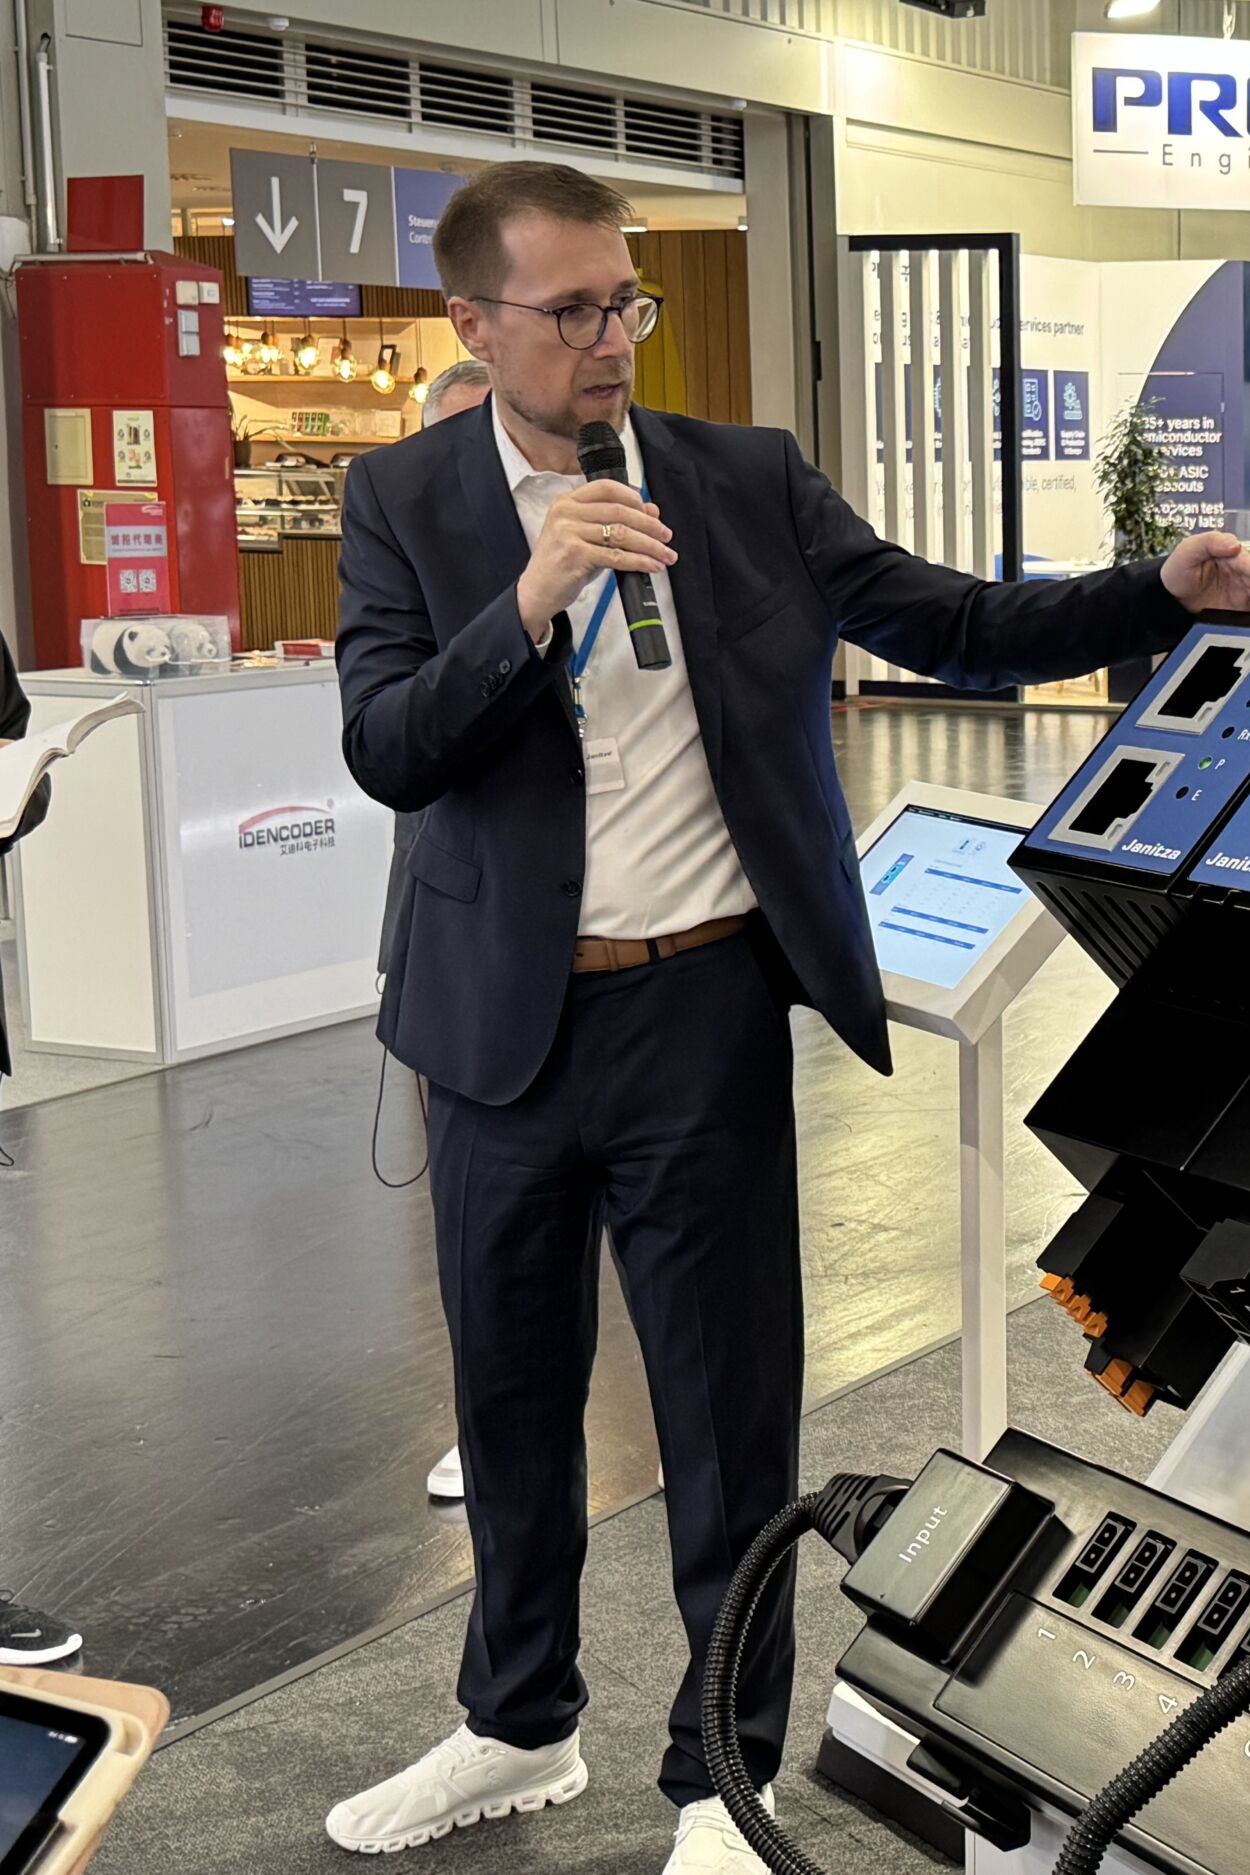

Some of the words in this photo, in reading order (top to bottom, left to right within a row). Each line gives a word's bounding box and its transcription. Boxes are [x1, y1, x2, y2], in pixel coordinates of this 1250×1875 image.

[343, 188, 368, 254] 7
[1053, 321, 1085, 338] partner
[1166, 419, 1201, 432] years
[1202, 416, 1215, 429] in
[1179, 466, 1209, 479] ASIC
[1201, 501, 1225, 514] test
[1214, 758, 1226, 770] P
[1191, 789, 1203, 801] E
[1121, 839, 1182, 861] Janitza
[1230, 1286, 1246, 1295] 1
[898, 1505, 948, 1563] Input
[1038, 1628, 1056, 1640] 1
[1072, 1650, 1096, 1669] 2
[1112, 1671, 1136, 1691] 3
[1158, 1694, 1178, 1714] 4
